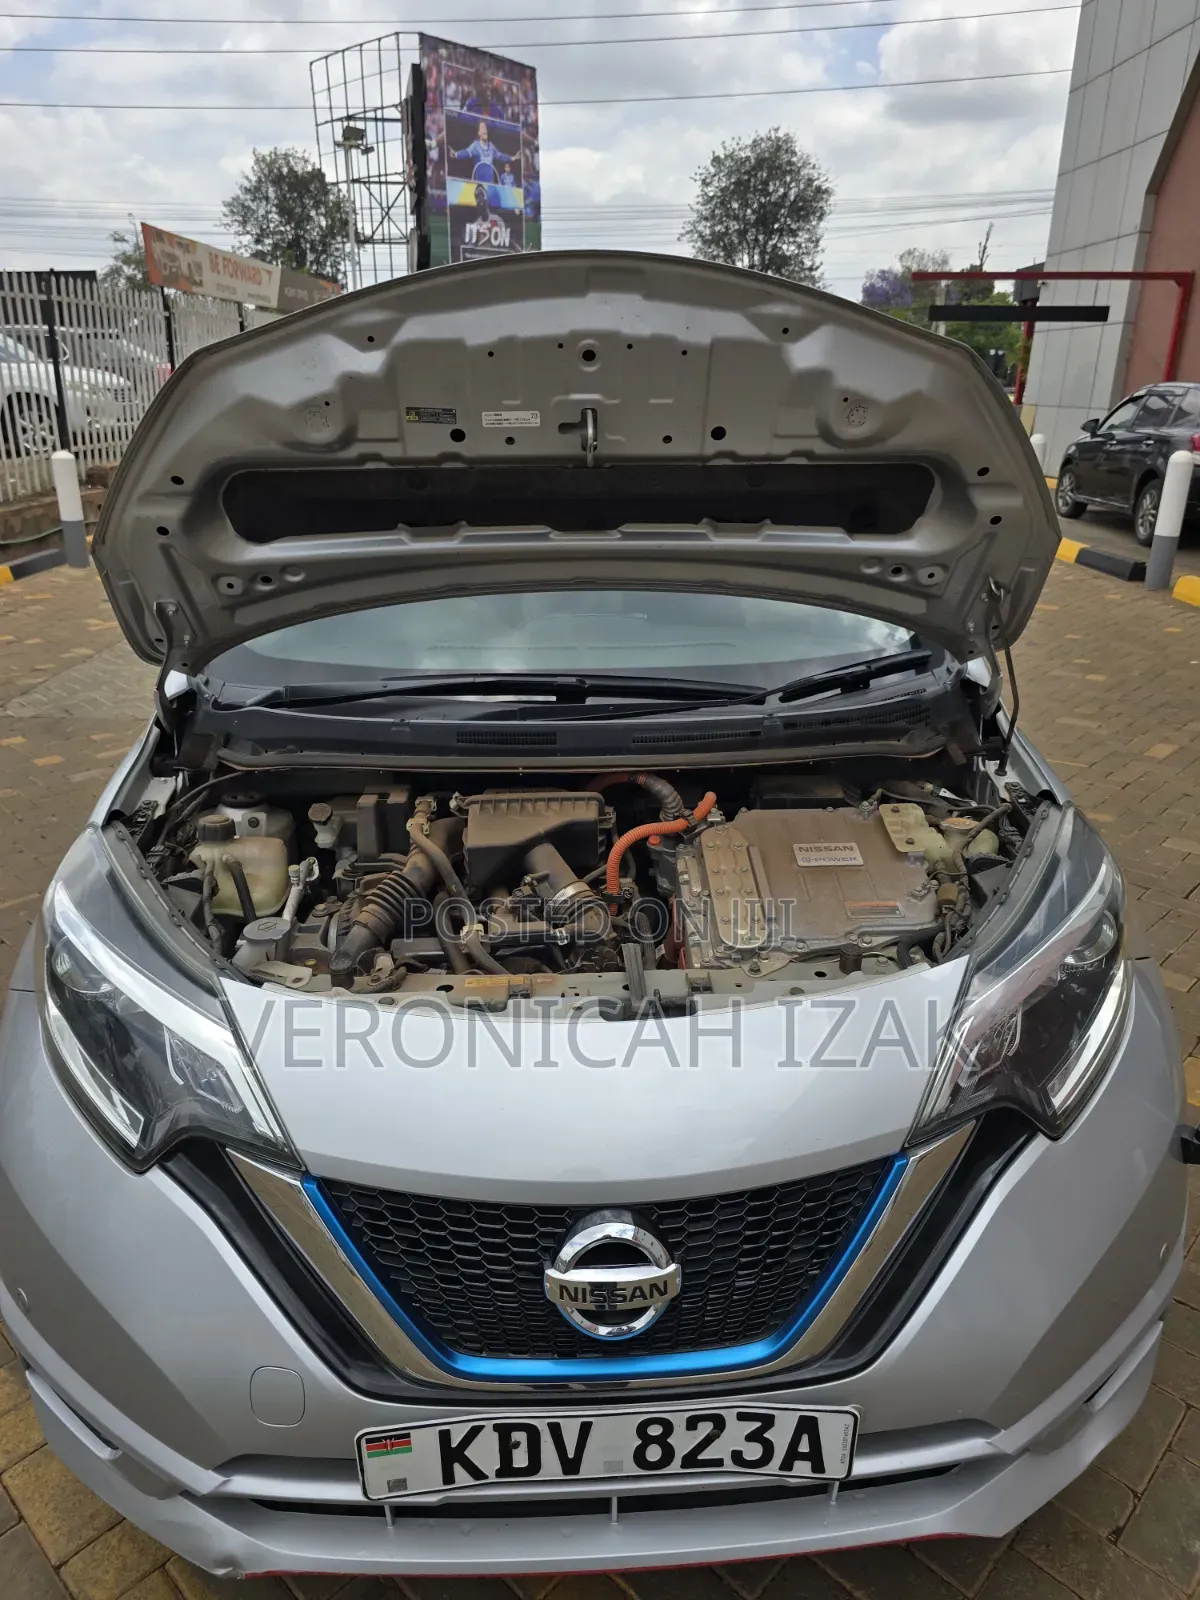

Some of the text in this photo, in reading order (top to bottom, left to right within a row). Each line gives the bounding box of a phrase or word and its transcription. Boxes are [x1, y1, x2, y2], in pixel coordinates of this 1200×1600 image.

[208, 252, 263, 286] BE FORWARD
[798, 845, 854, 853] NISSAN
[558, 1280, 668, 1305] NISSAN
[438, 1420, 594, 1487] KDV
[632, 1412, 827, 1475] 823A
